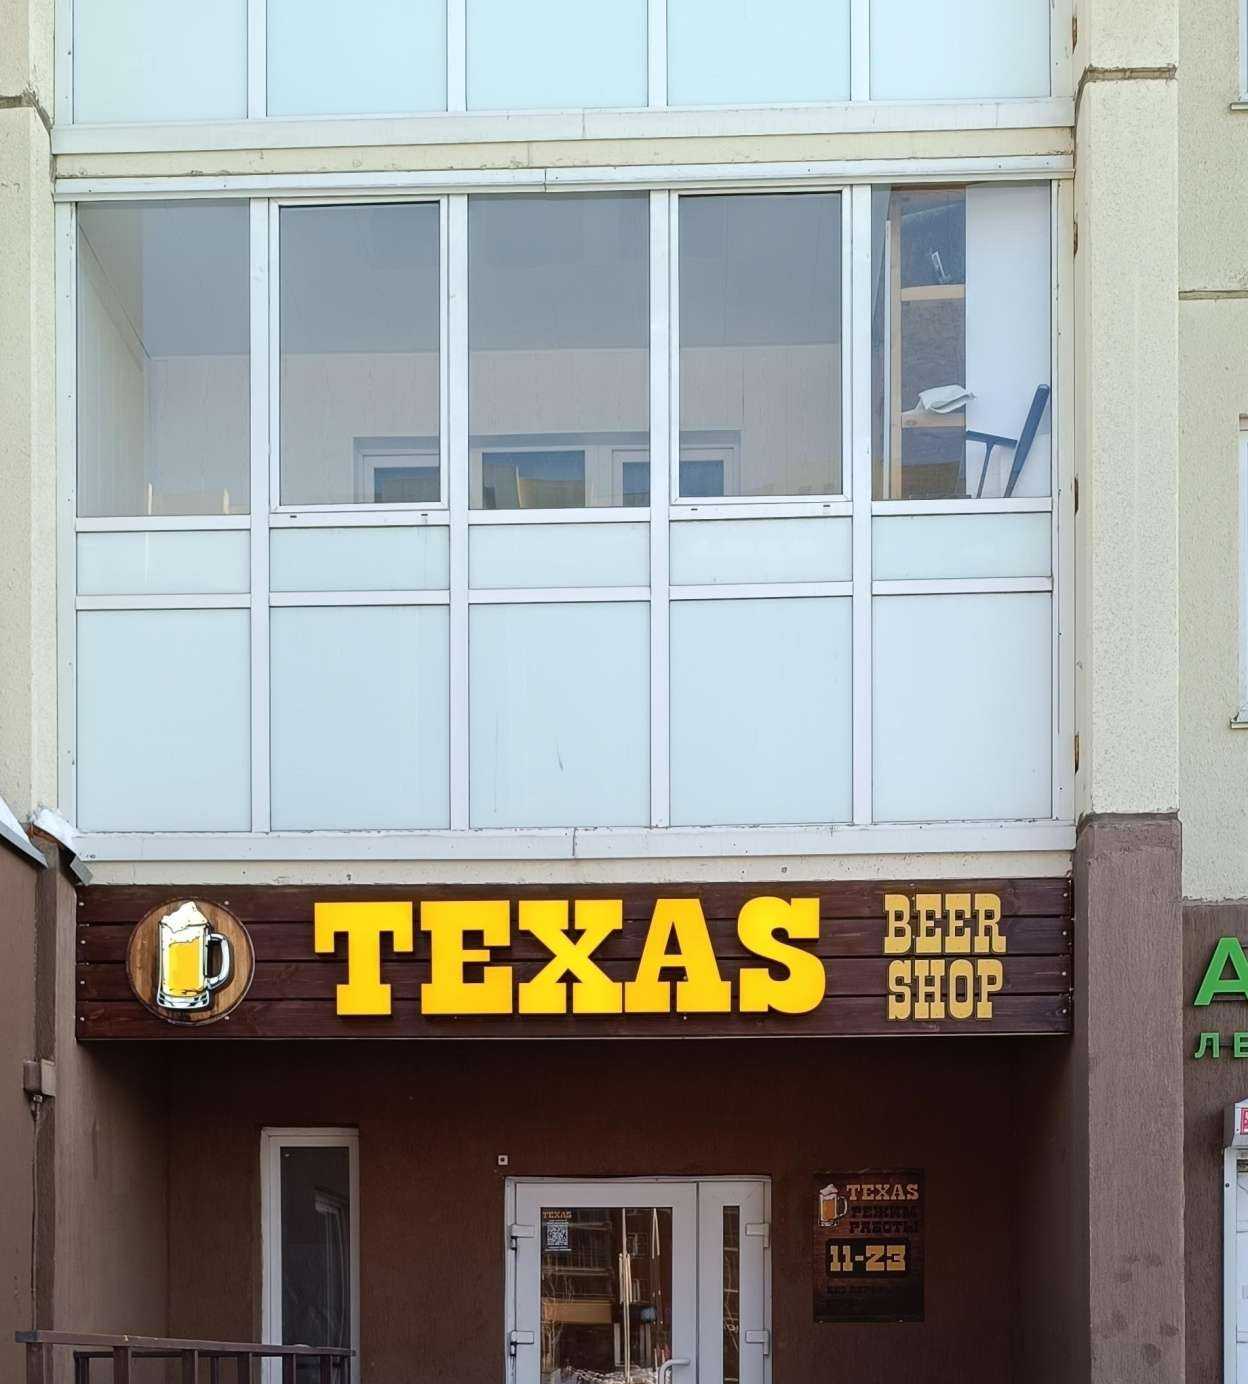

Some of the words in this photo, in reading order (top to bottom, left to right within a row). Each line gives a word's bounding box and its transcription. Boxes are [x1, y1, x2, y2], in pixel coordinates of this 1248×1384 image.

[884, 893, 1007, 954] BEER
[314, 896, 826, 1016] TEXAS
[888, 958, 1004, 1020] SHOP
[846, 1183, 920, 1201] TEXAS
[848, 1220, 920, 1234] РАБОТЫ
[829, 1244, 907, 1272] 11-23
